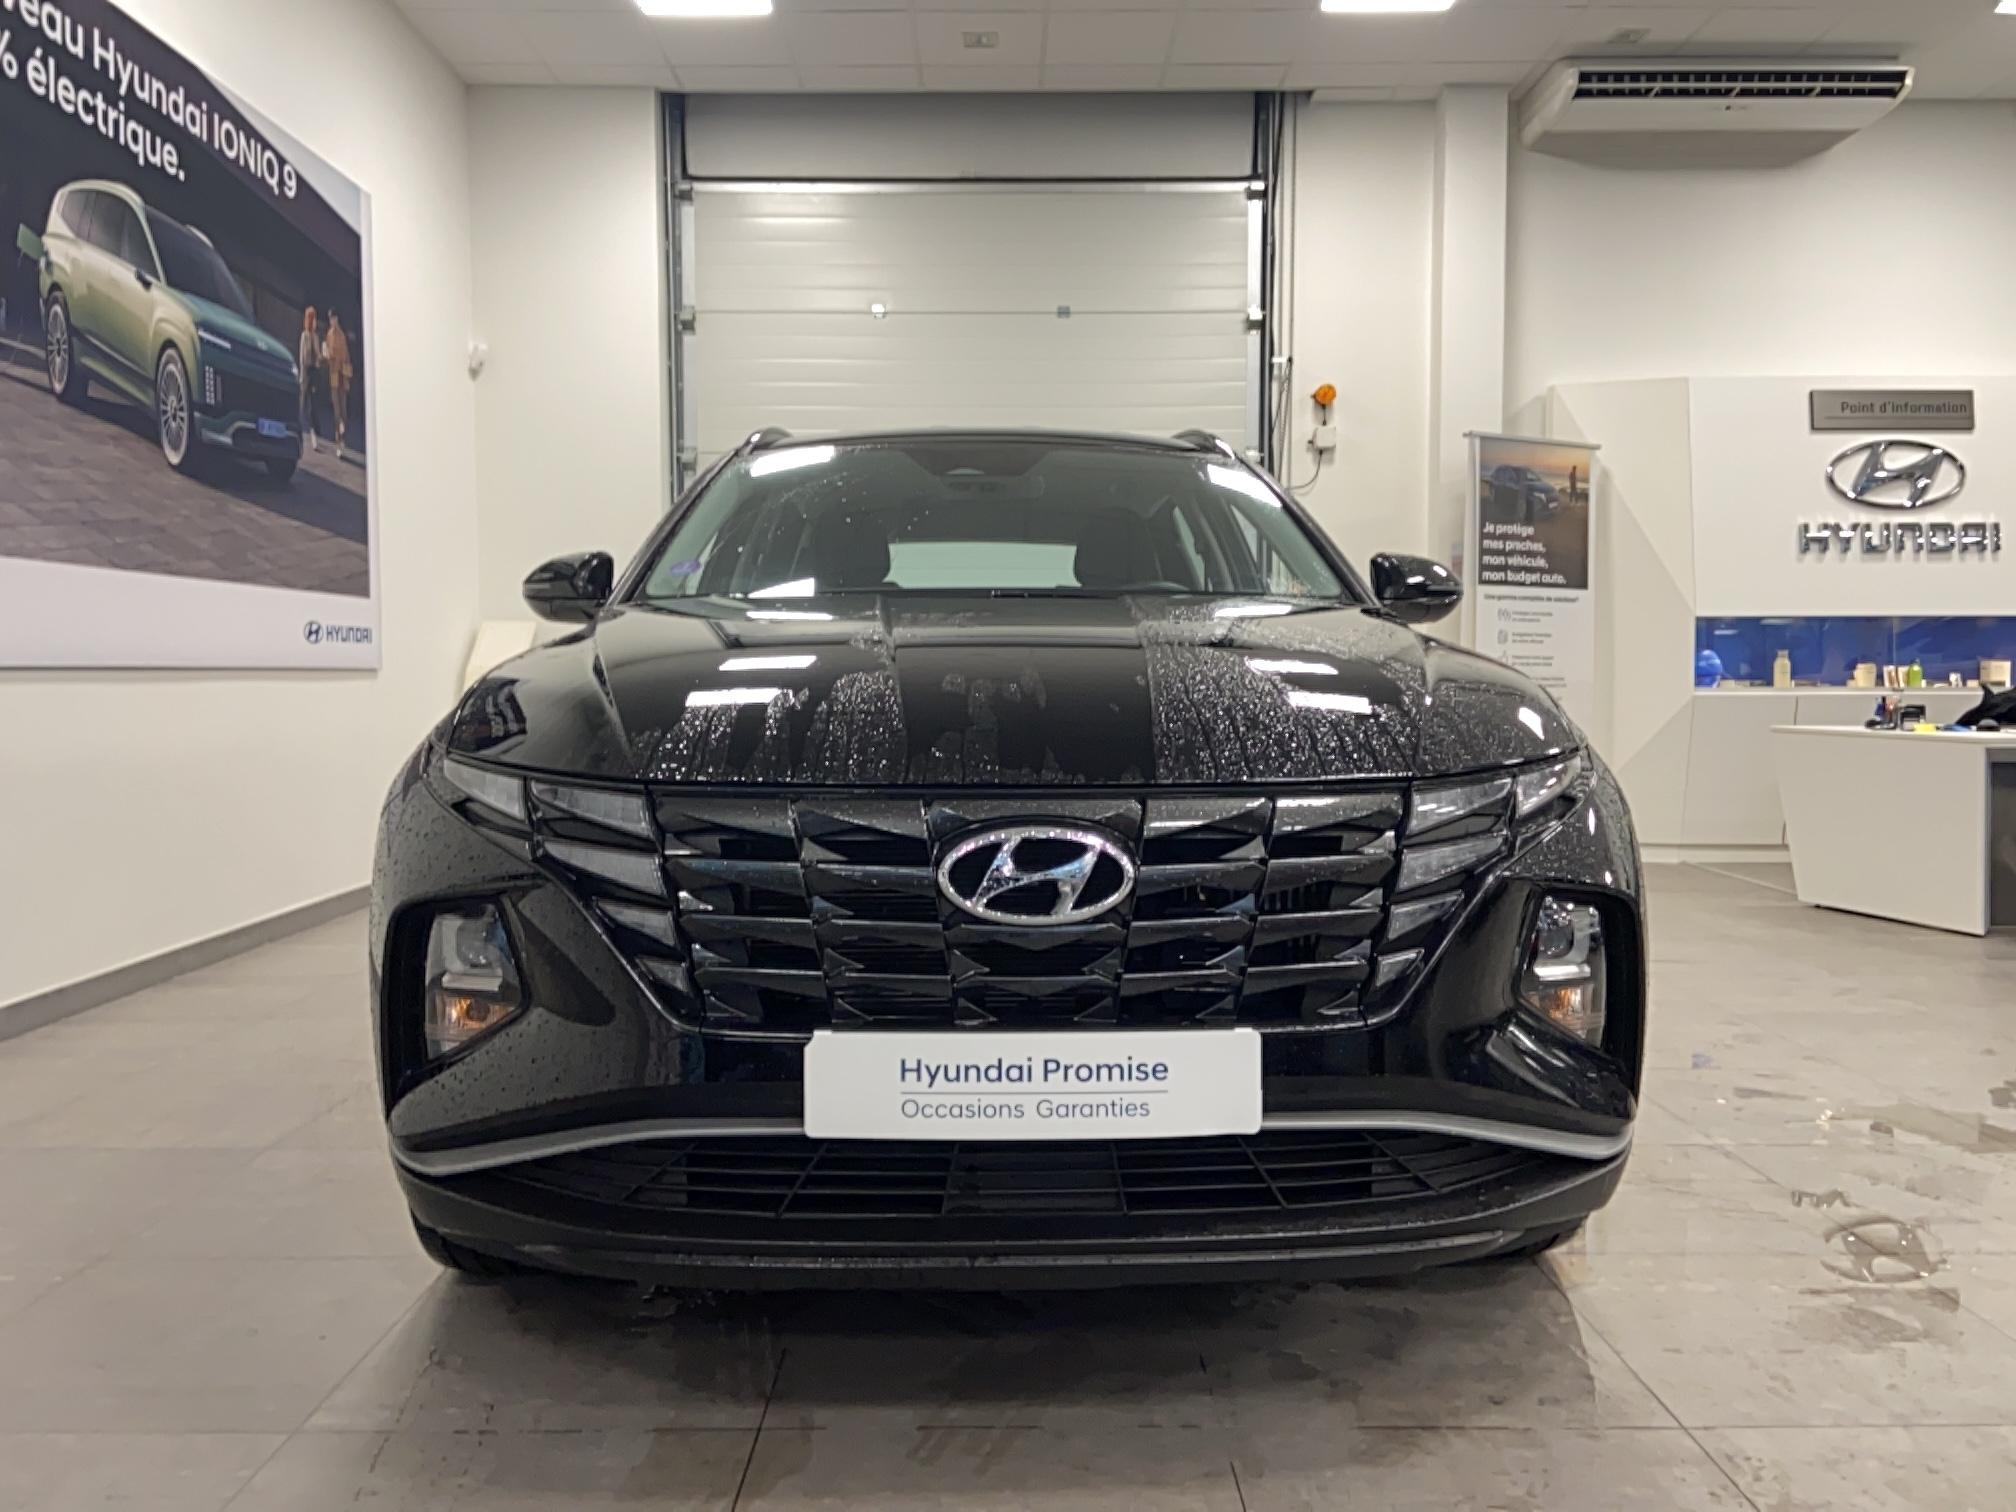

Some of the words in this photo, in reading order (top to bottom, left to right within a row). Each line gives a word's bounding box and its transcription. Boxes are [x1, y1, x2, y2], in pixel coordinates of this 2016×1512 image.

[26, 46, 186, 182] électrique.
[93, 27, 208, 141] Hyundai
[213, 113, 279, 195] IONIQ
[283, 166, 298, 199] 9
[1840, 401, 1875, 414] Point
[1879, 401, 1967, 414] d'information
[1483, 522, 1495, 534] Je
[1799, 522, 2001, 554] HYUNDAI
[1483, 539, 1504, 550] mes
[1482, 555, 1506, 566] mon
[1482, 571, 1506, 582] mon
[1507, 569, 1540, 584] budget
[326, 624, 373, 644] HYUNDAI
[900, 1057, 1033, 1088] Hyundai
[1043, 1056, 1169, 1082] Promise
[901, 1098, 1025, 1120] Occasions
[1036, 1097, 1151, 1119] Garanties
